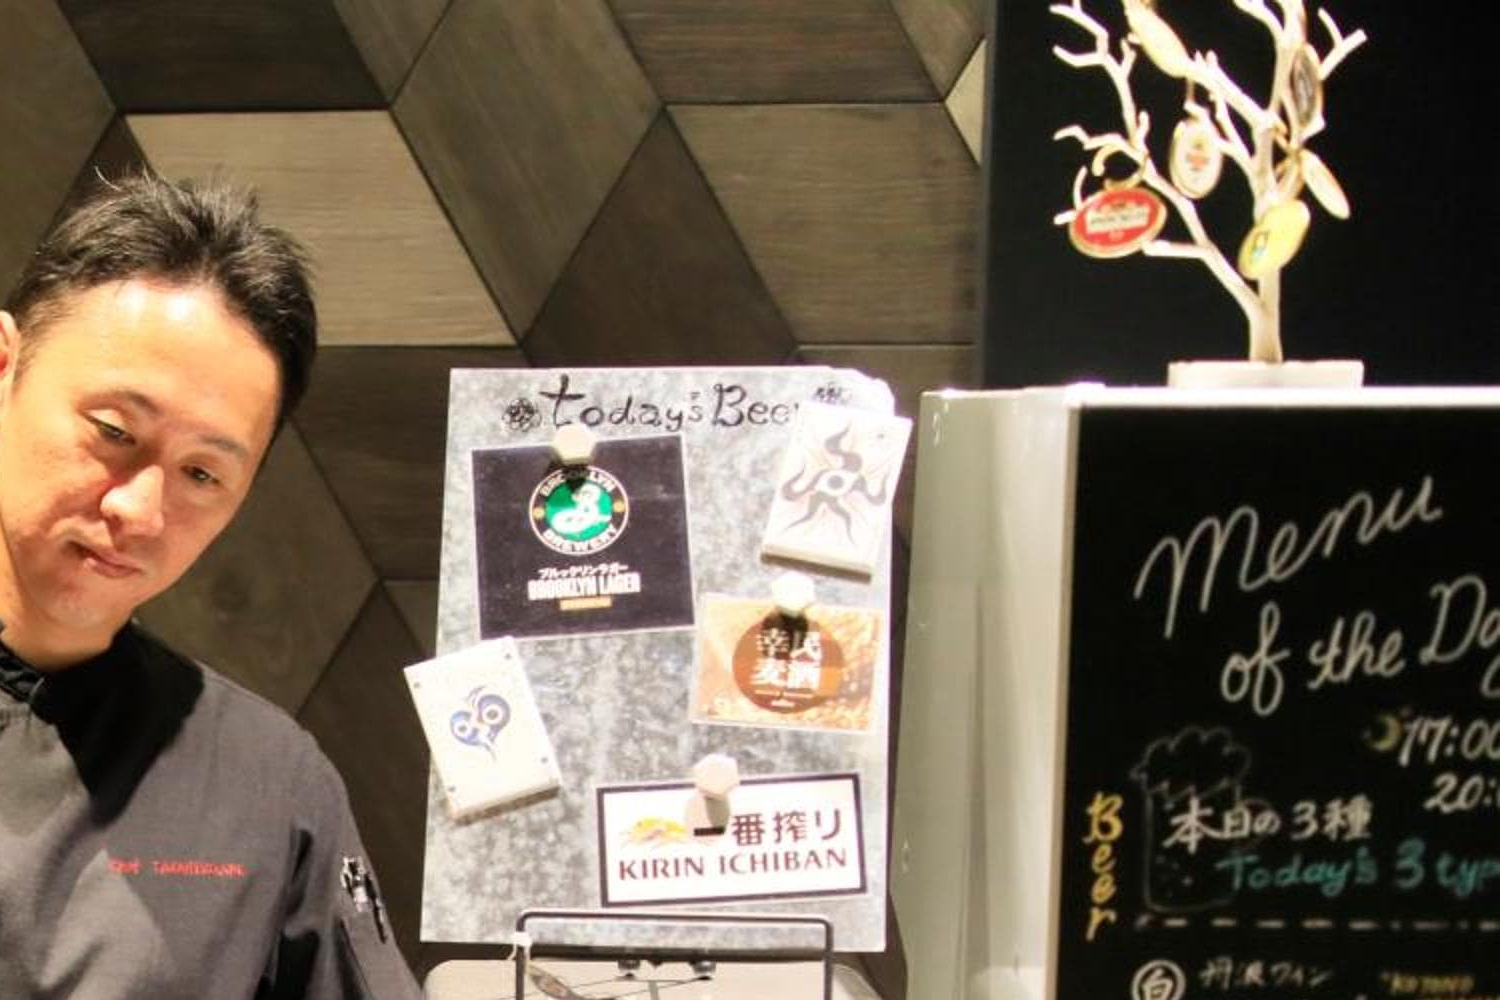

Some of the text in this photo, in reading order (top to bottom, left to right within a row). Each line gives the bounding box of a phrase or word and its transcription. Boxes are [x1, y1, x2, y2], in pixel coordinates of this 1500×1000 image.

[712, 383, 800, 427] Bee
[540, 470, 617, 497] BROLYN
[542, 524, 618, 553] BREWERY
[1134, 476, 1442, 638] Menu
[528, 571, 641, 601] BROOKLYN LAGER
[1220, 600, 1291, 717] of
[1307, 610, 1407, 690] the
[1422, 771, 1500, 814] 20:
[693, 808, 842, 848] 一番搾り
[618, 847, 848, 883] KIRIN ICHIBAN
[1083, 792, 1124, 941] Beer
[1214, 846, 1379, 898] Today's
[1394, 837, 1426, 890] 3
